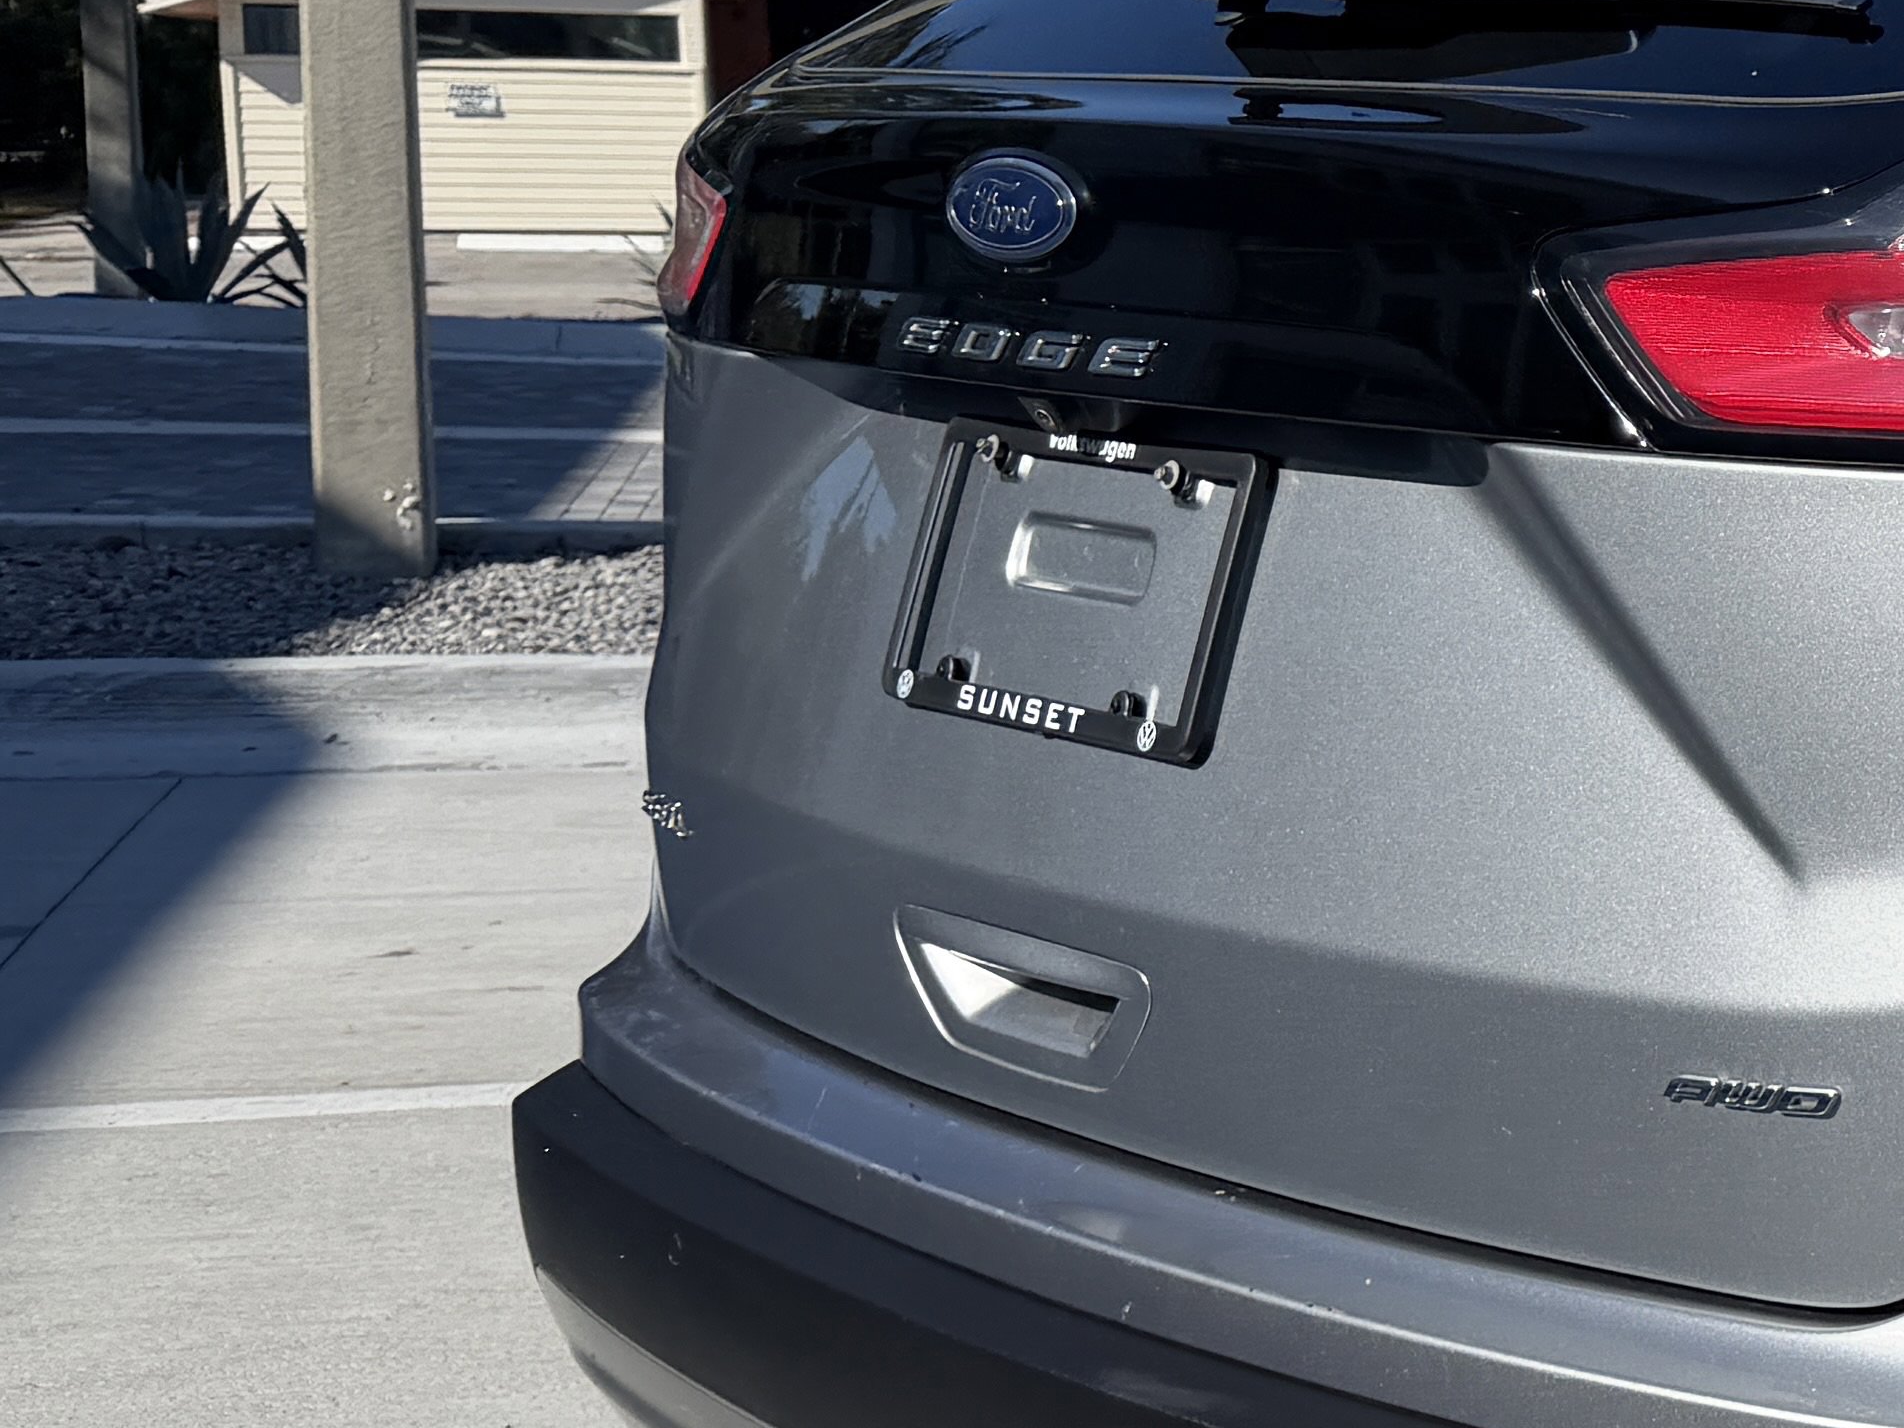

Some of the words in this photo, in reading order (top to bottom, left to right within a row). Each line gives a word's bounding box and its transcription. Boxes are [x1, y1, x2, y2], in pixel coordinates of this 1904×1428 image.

[969, 178, 1037, 233] Ford
[899, 316, 1159, 377] EDGE
[956, 684, 1086, 733] SUNSET
[1663, 1074, 1842, 1119] AWD
